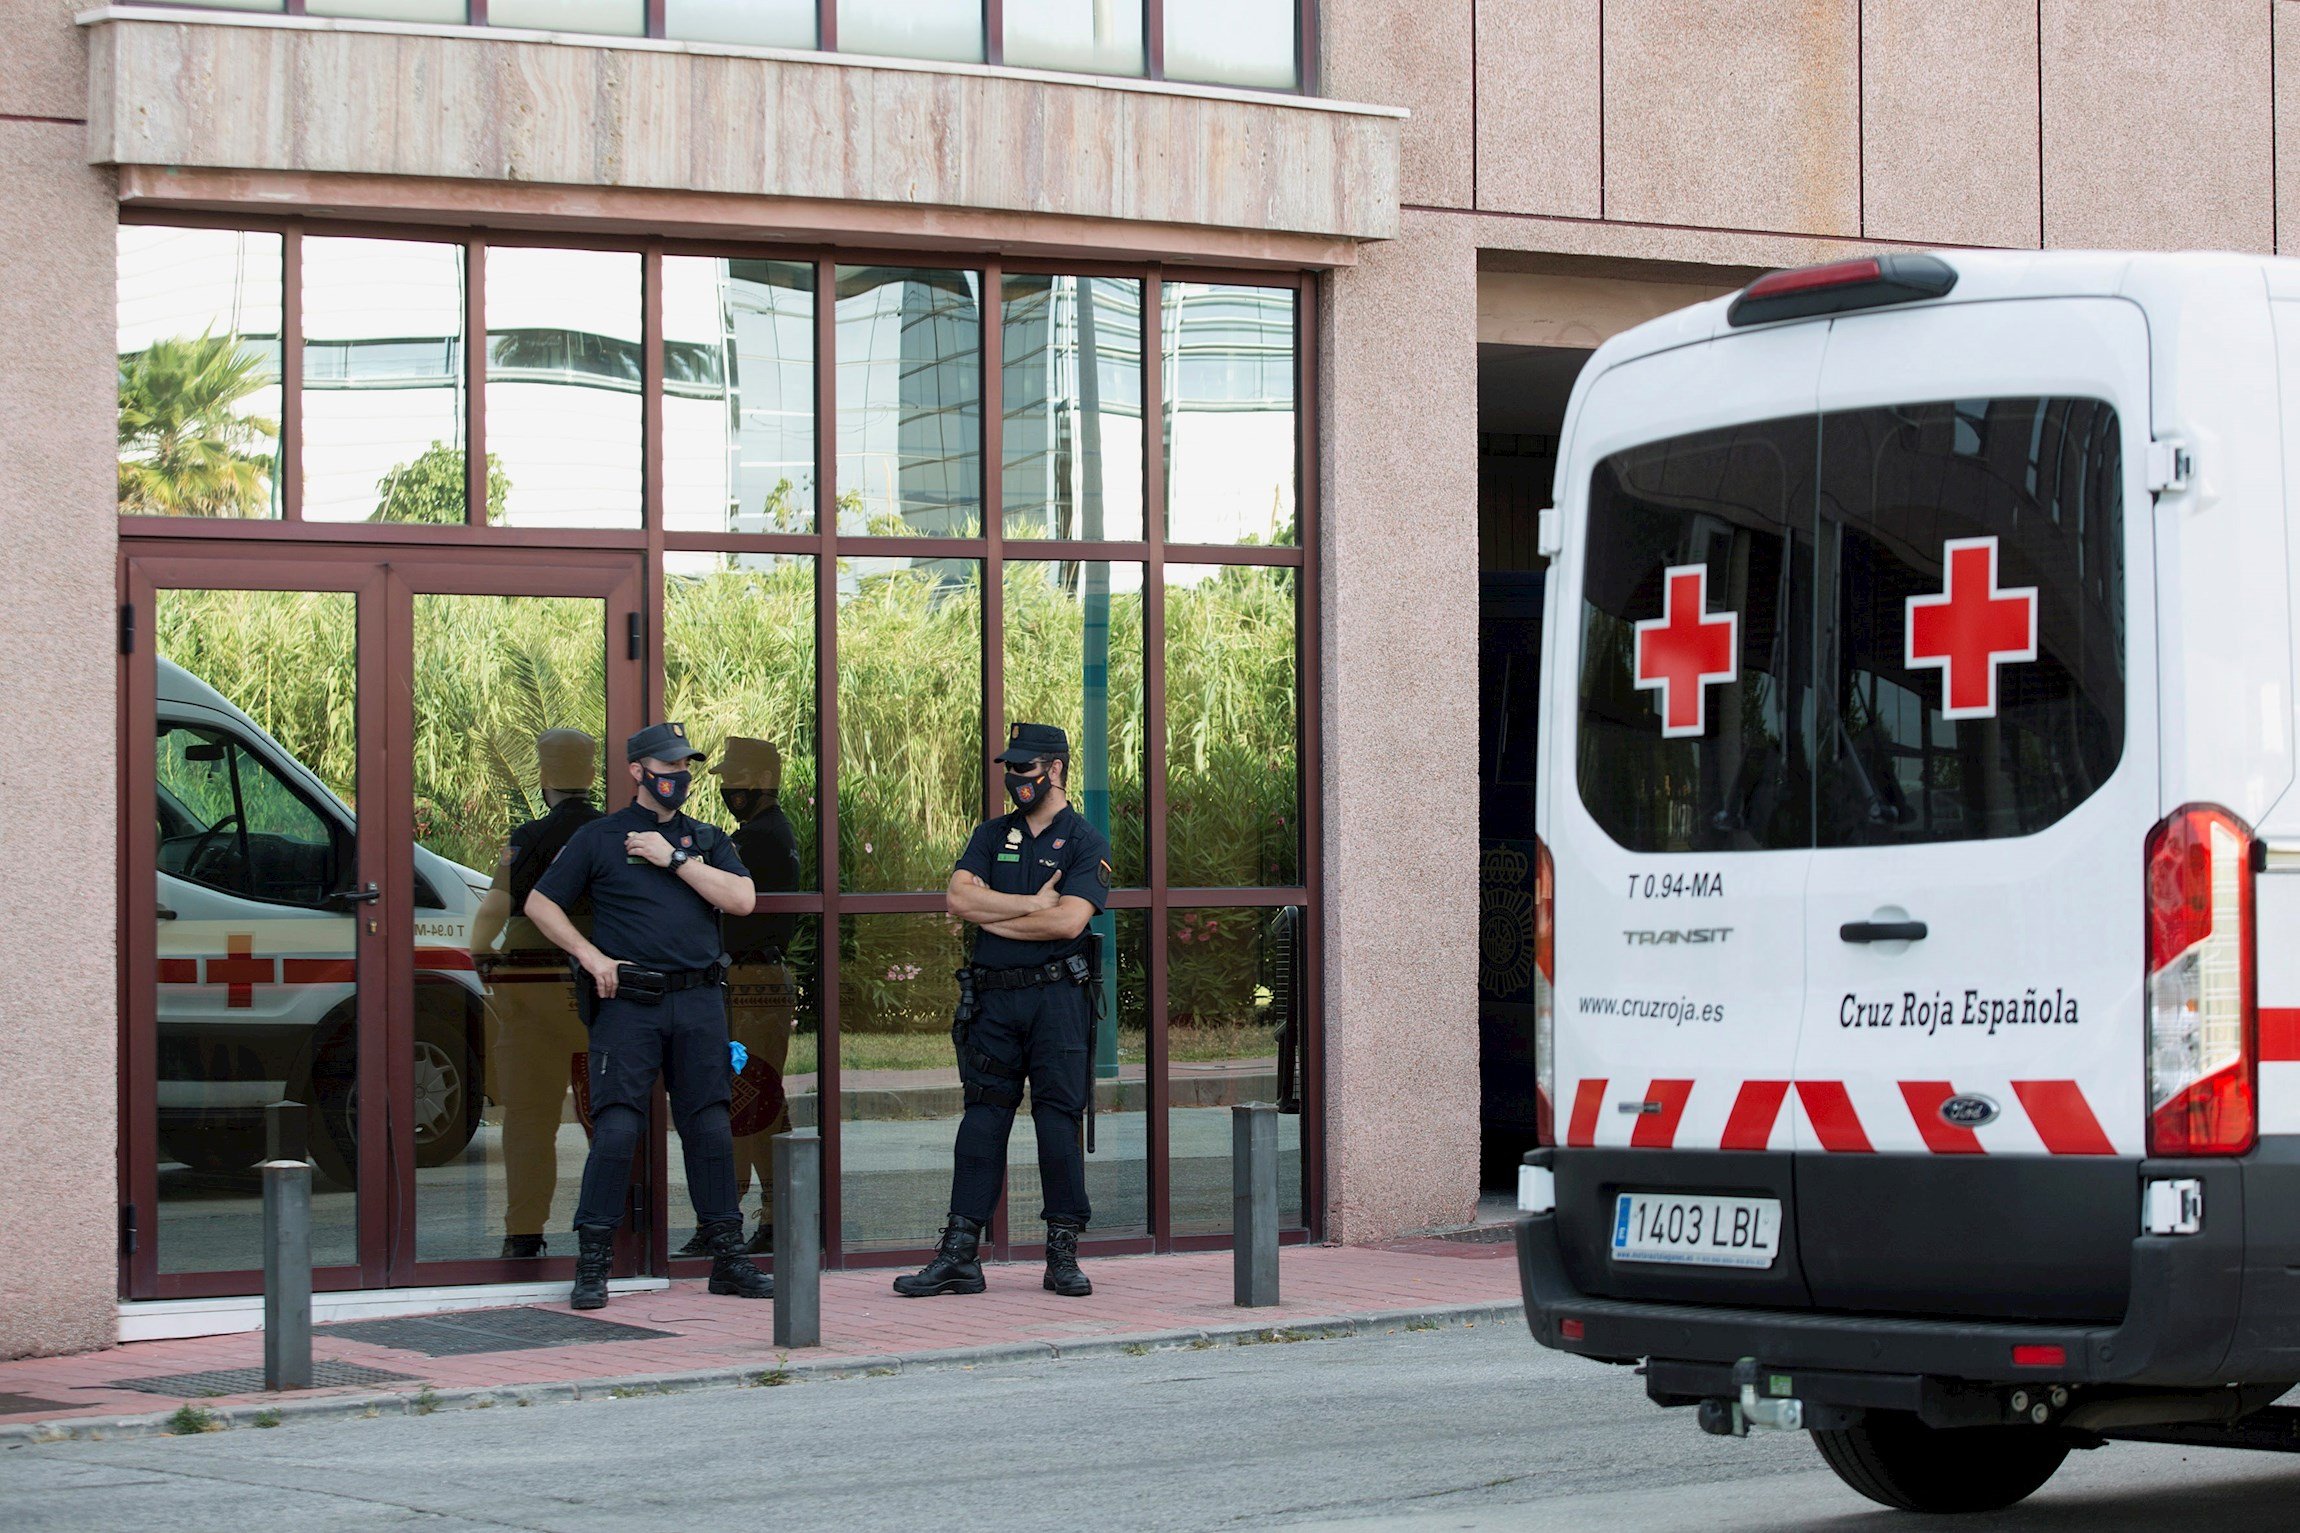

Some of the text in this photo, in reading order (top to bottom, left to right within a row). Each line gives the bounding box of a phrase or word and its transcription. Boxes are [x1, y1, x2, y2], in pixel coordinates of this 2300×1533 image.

[1629, 872, 1723, 898] T 0.94-MA
[1622, 927, 1734, 946] TRANSIT
[1579, 995, 1725, 1027] www.cruzroja.es
[1840, 987, 2079, 1036] Cruz Roja Española
[1637, 1202, 1704, 1244] 1403
[1712, 1205, 1768, 1248] LBL
